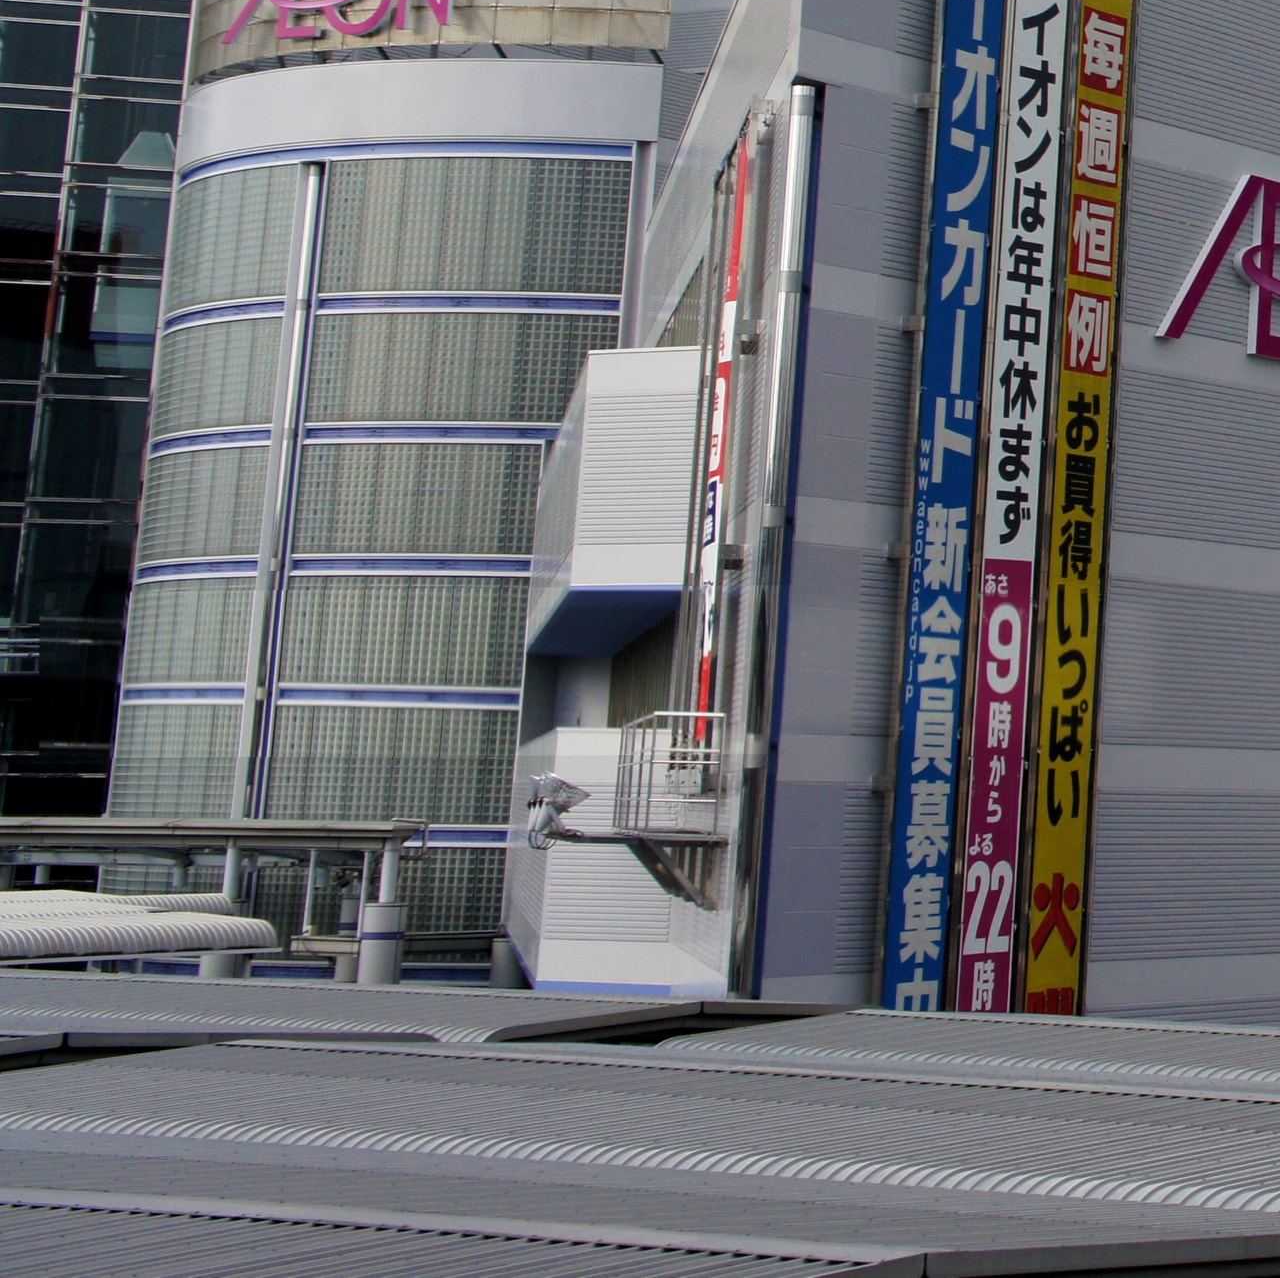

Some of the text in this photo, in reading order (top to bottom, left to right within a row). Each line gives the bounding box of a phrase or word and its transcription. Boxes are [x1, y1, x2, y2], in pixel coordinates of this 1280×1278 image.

[995, 2, 1060, 545] イオンは年中休まず
